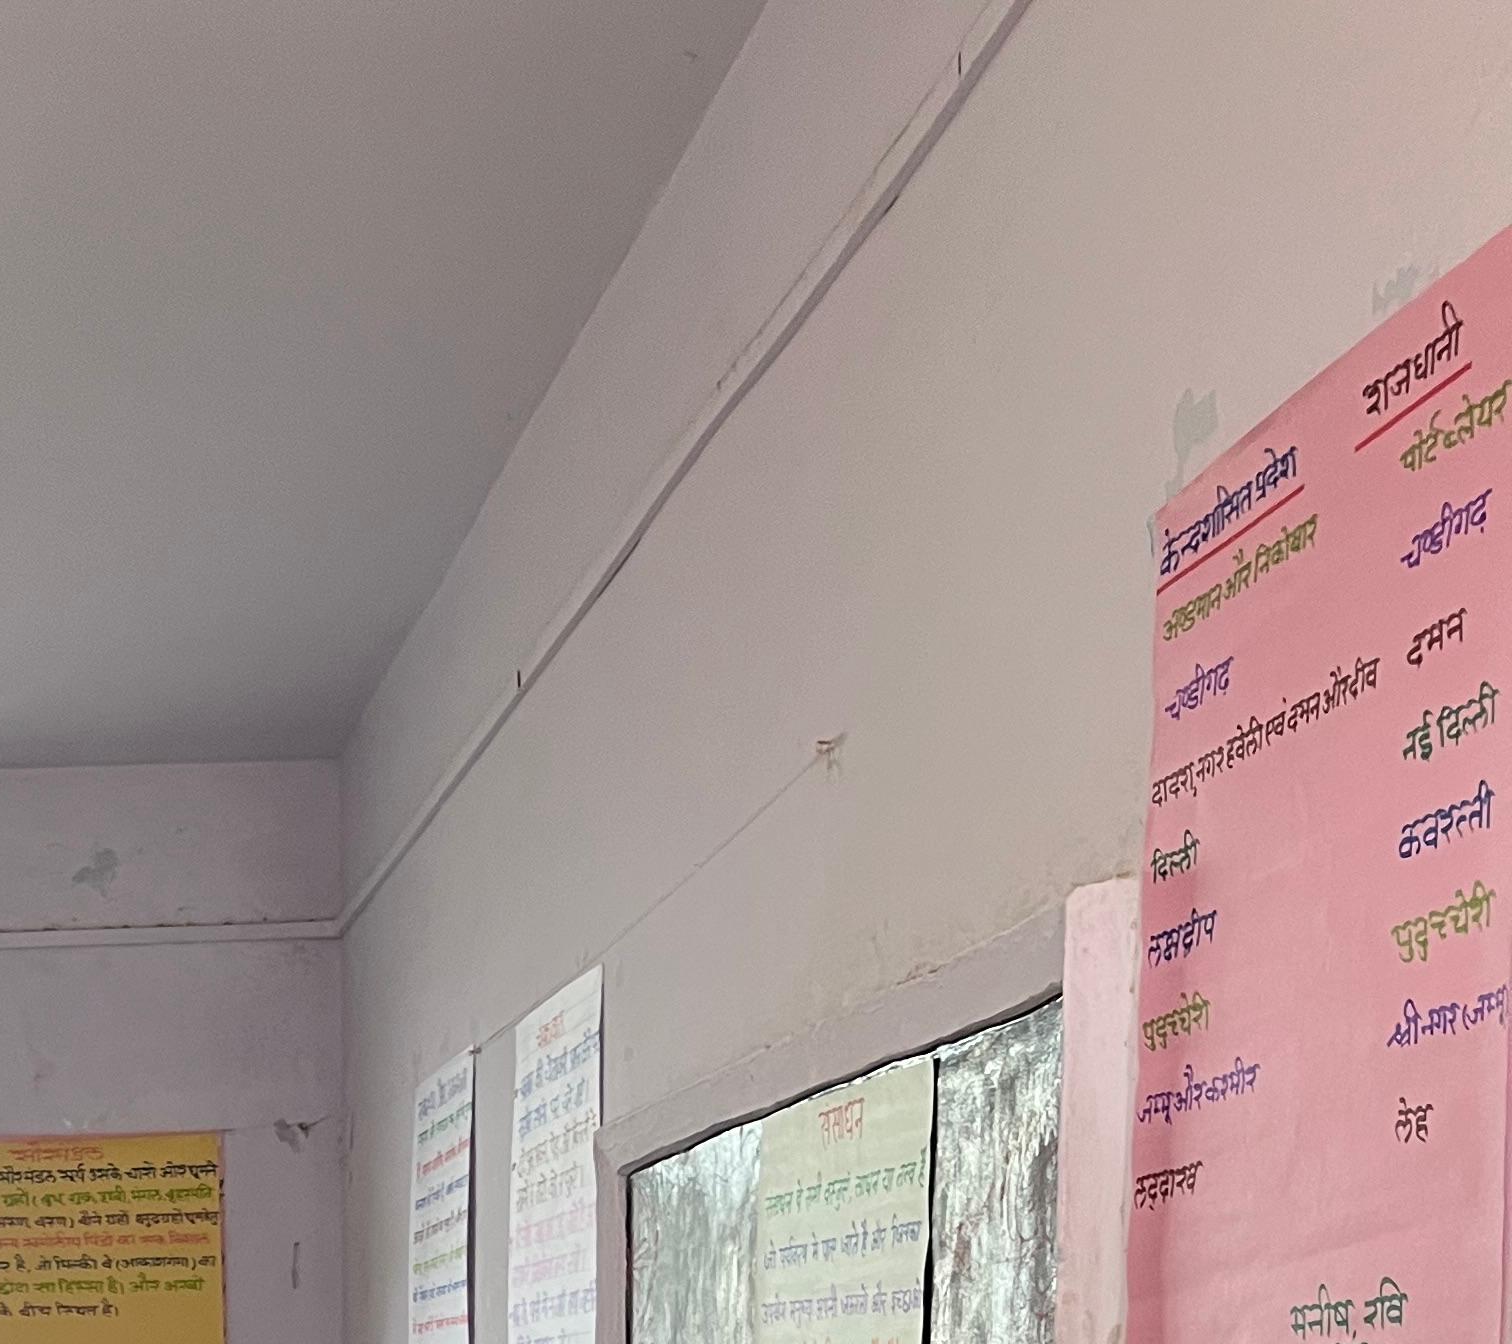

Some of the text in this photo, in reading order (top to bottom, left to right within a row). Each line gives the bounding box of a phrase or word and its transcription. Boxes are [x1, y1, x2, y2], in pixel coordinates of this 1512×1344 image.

[1362, 300, 1465, 415] राजधानी
[1406, 607, 1468, 668] दमन
[1403, 680, 1500, 762] नई दिल्ली
[1150, 829, 1201, 884] दिल्ली
[1394, 1096, 1434, 1144] लेह
[1363, 1276, 1409, 1330] रवि
